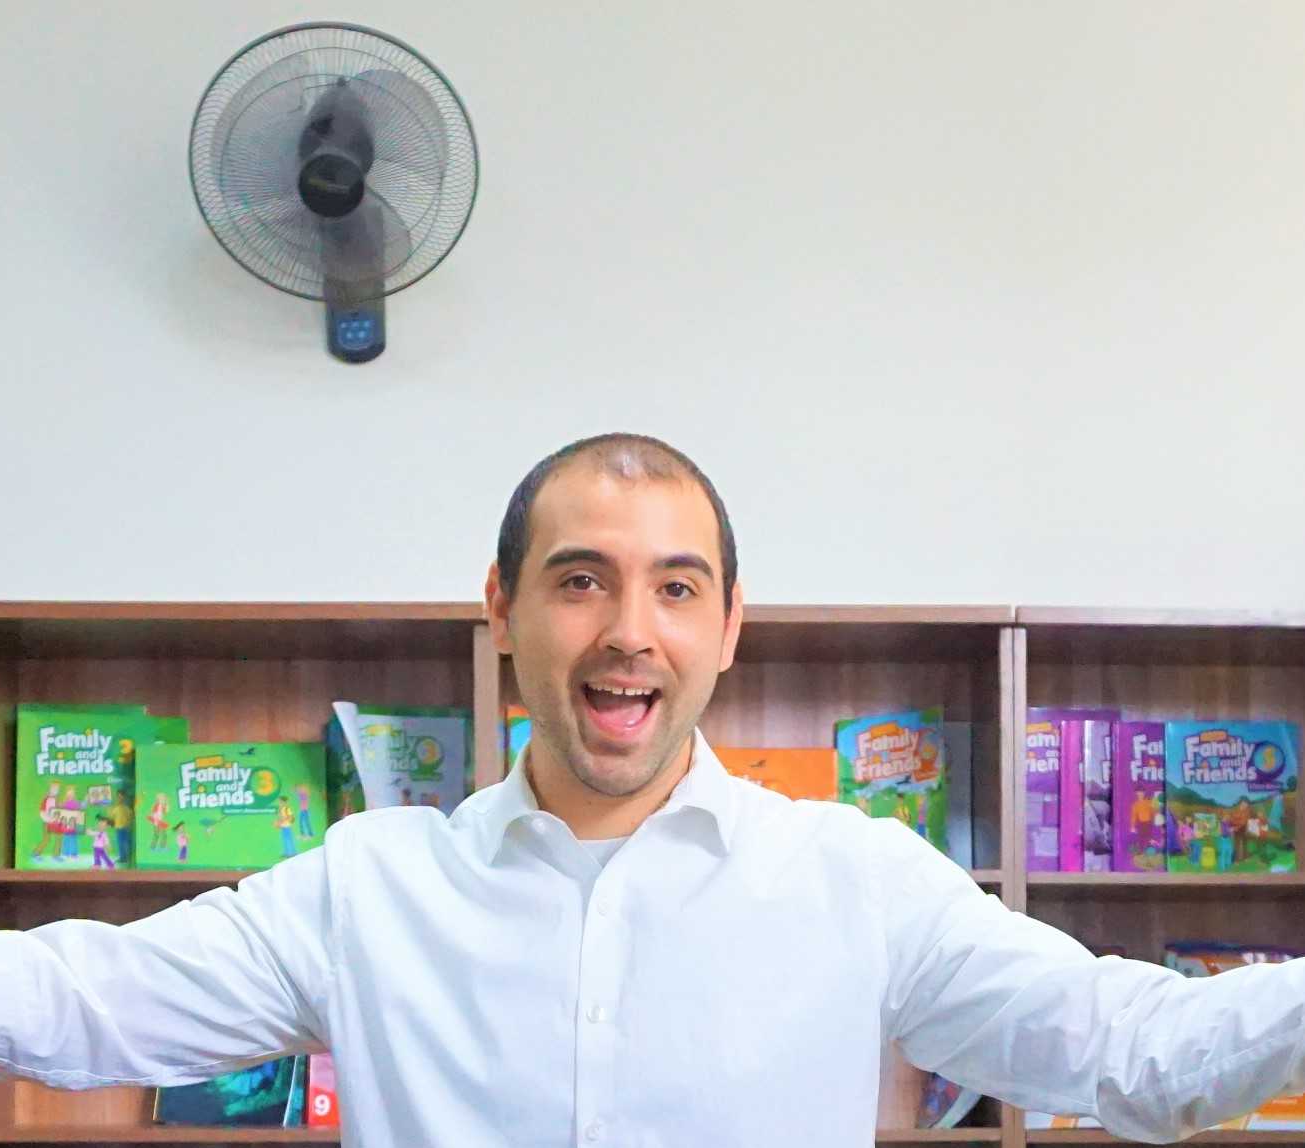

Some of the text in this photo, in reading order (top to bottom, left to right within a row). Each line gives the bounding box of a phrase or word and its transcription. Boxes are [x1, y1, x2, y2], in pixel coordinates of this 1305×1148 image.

[40, 727, 112, 754] Family
[858, 728, 919, 758] Family
[1186, 736, 1255, 762] Family
[37, 751, 113, 775] Friends
[76, 749, 97, 760] and
[181, 761, 251, 787] Family
[855, 754, 919, 782] Friends
[1183, 758, 1257, 783] Friends
[216, 782, 236, 793] and
[256, 769, 273, 796] 3
[178, 784, 254, 809] Friends
[314, 1094, 331, 1116] 9
